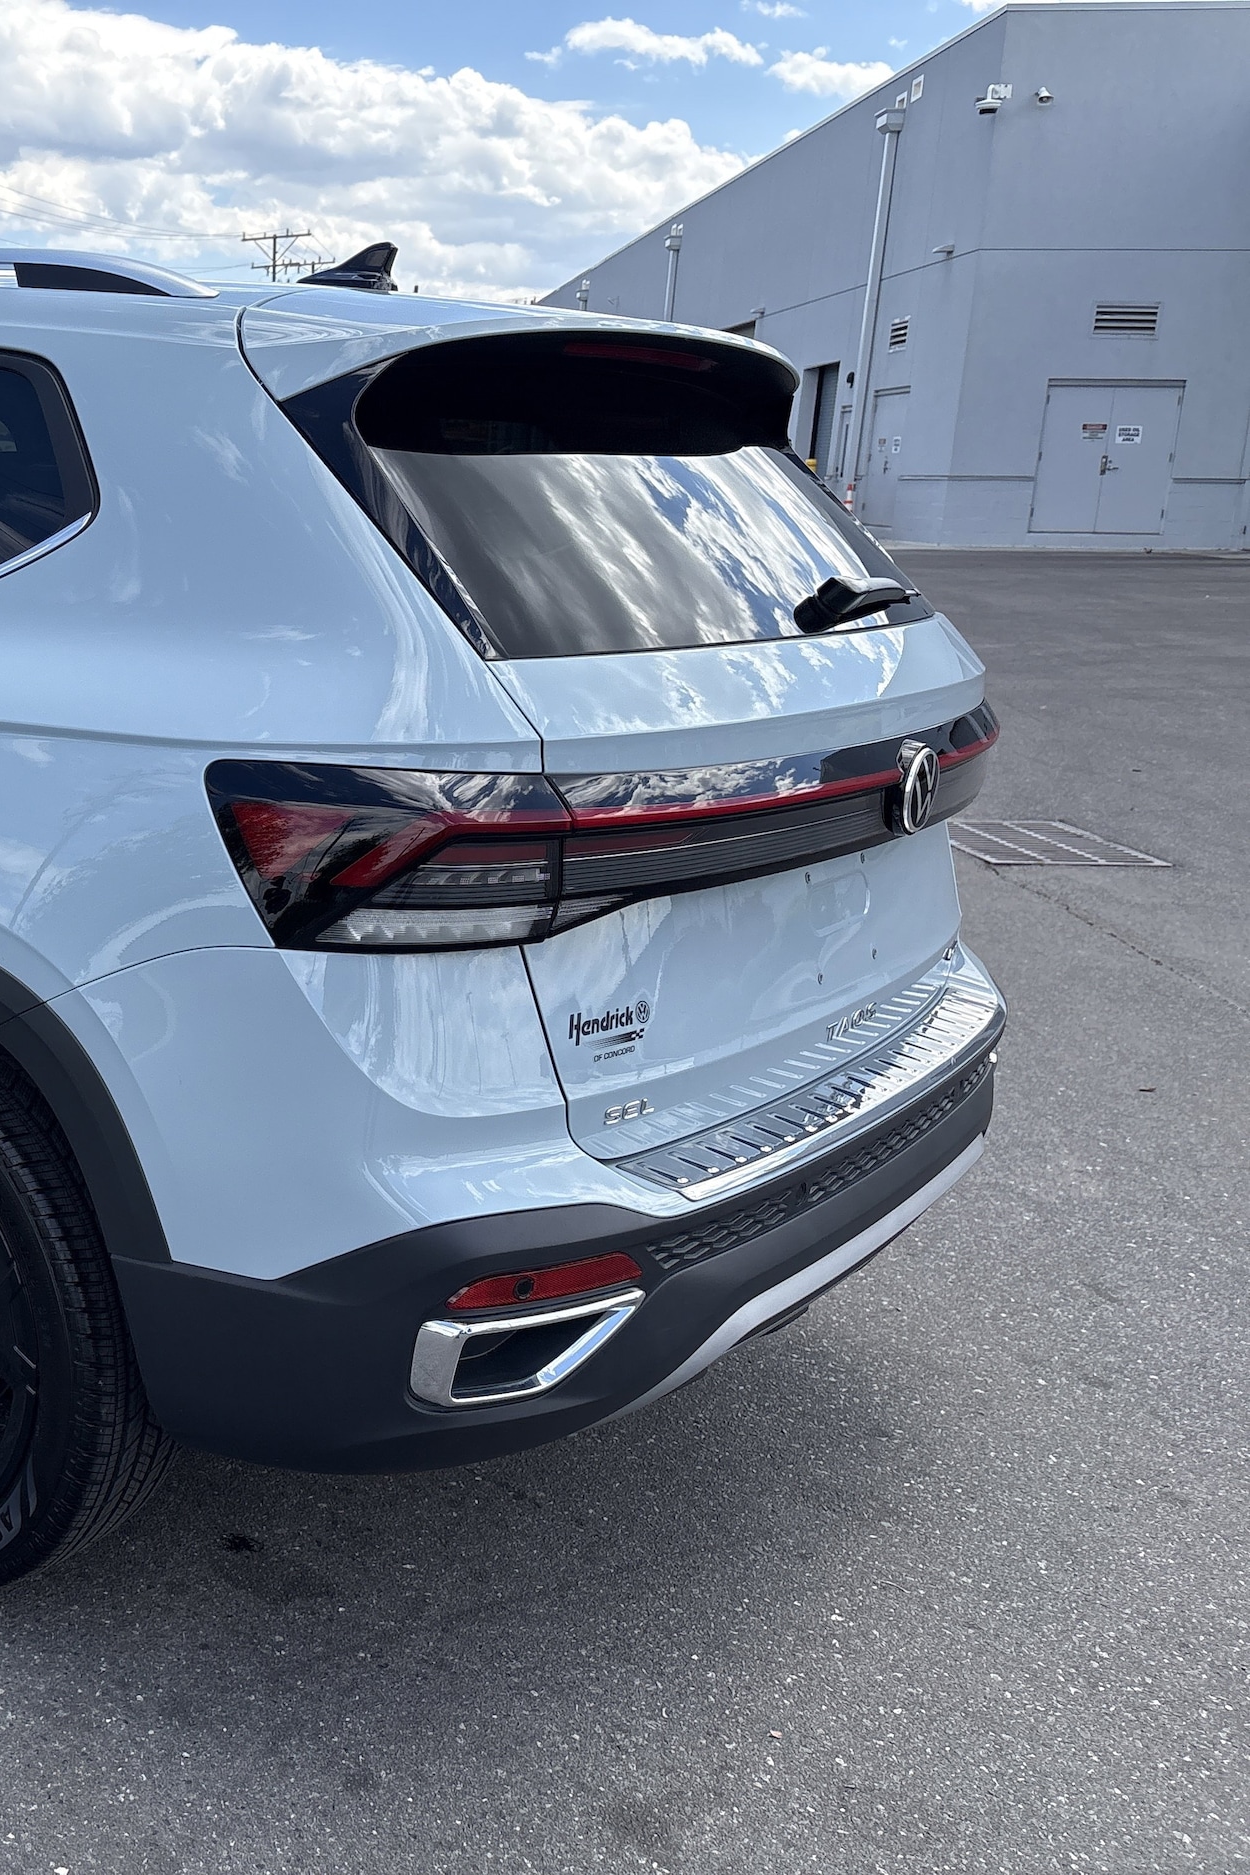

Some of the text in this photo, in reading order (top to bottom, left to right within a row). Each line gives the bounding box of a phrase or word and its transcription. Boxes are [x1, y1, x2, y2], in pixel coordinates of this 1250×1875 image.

[568, 1006, 634, 1046] Hendrick
[593, 1045, 636, 1063] OF CONCORD
[603, 1098, 655, 1125] SEL
